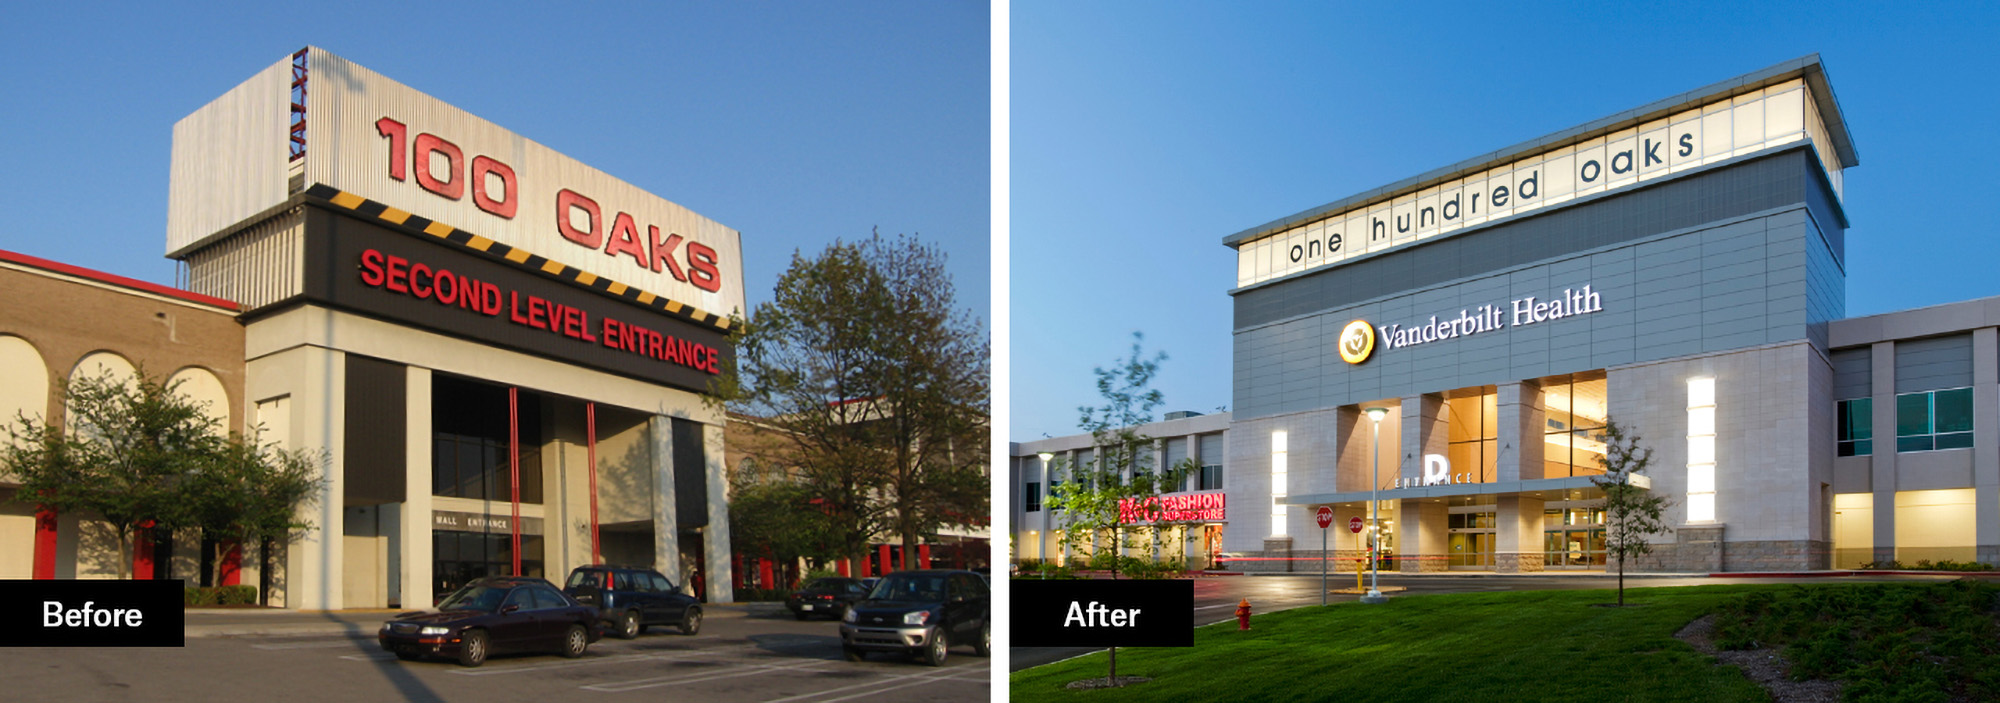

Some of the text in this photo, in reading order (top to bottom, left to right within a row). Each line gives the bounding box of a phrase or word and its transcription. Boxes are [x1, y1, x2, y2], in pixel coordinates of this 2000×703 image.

[375, 116, 721, 293] 100 OAKS
[1290, 132, 1694, 263] one hundred oaks
[360, 249, 720, 374] SECOND LEVEL ENTRANCE
[1377, 285, 1603, 351] Vanderbilt Health
[1161, 493, 1225, 511] FASHION
[1161, 508, 1225, 522] SUPERSTORE
